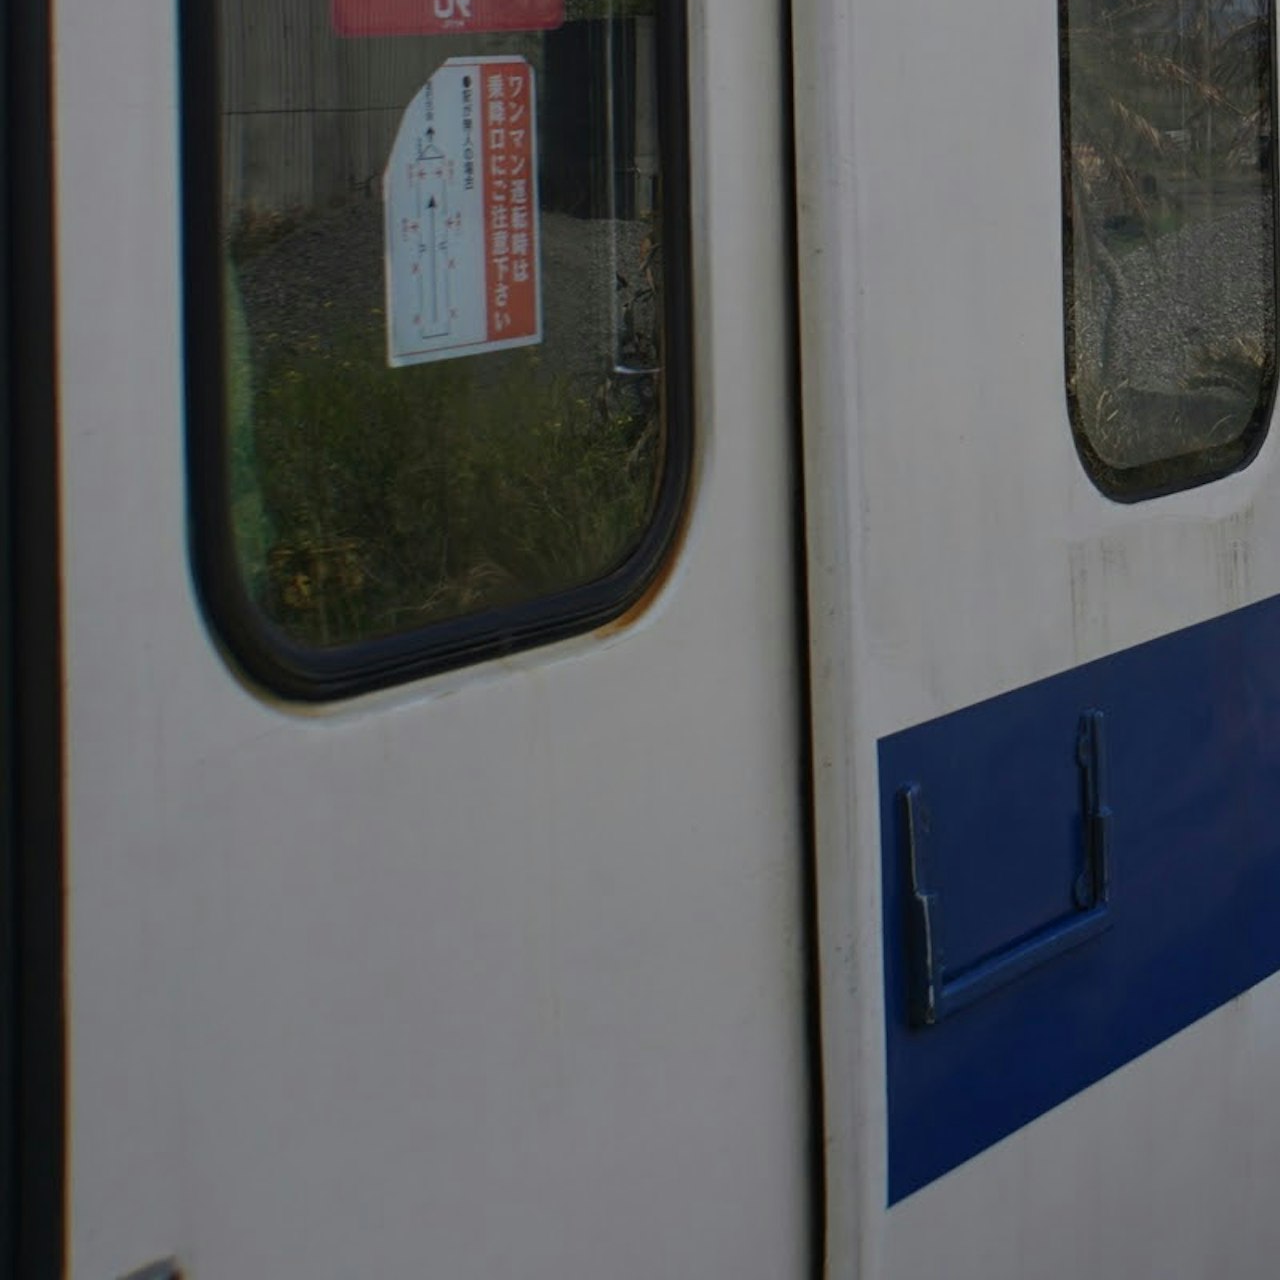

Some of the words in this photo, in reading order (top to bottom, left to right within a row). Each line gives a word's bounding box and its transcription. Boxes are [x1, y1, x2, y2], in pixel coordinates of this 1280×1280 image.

[487, 74, 511, 332] 乗降口にご注意下さい
[508, 75, 529, 282] ワンマン運転時は
